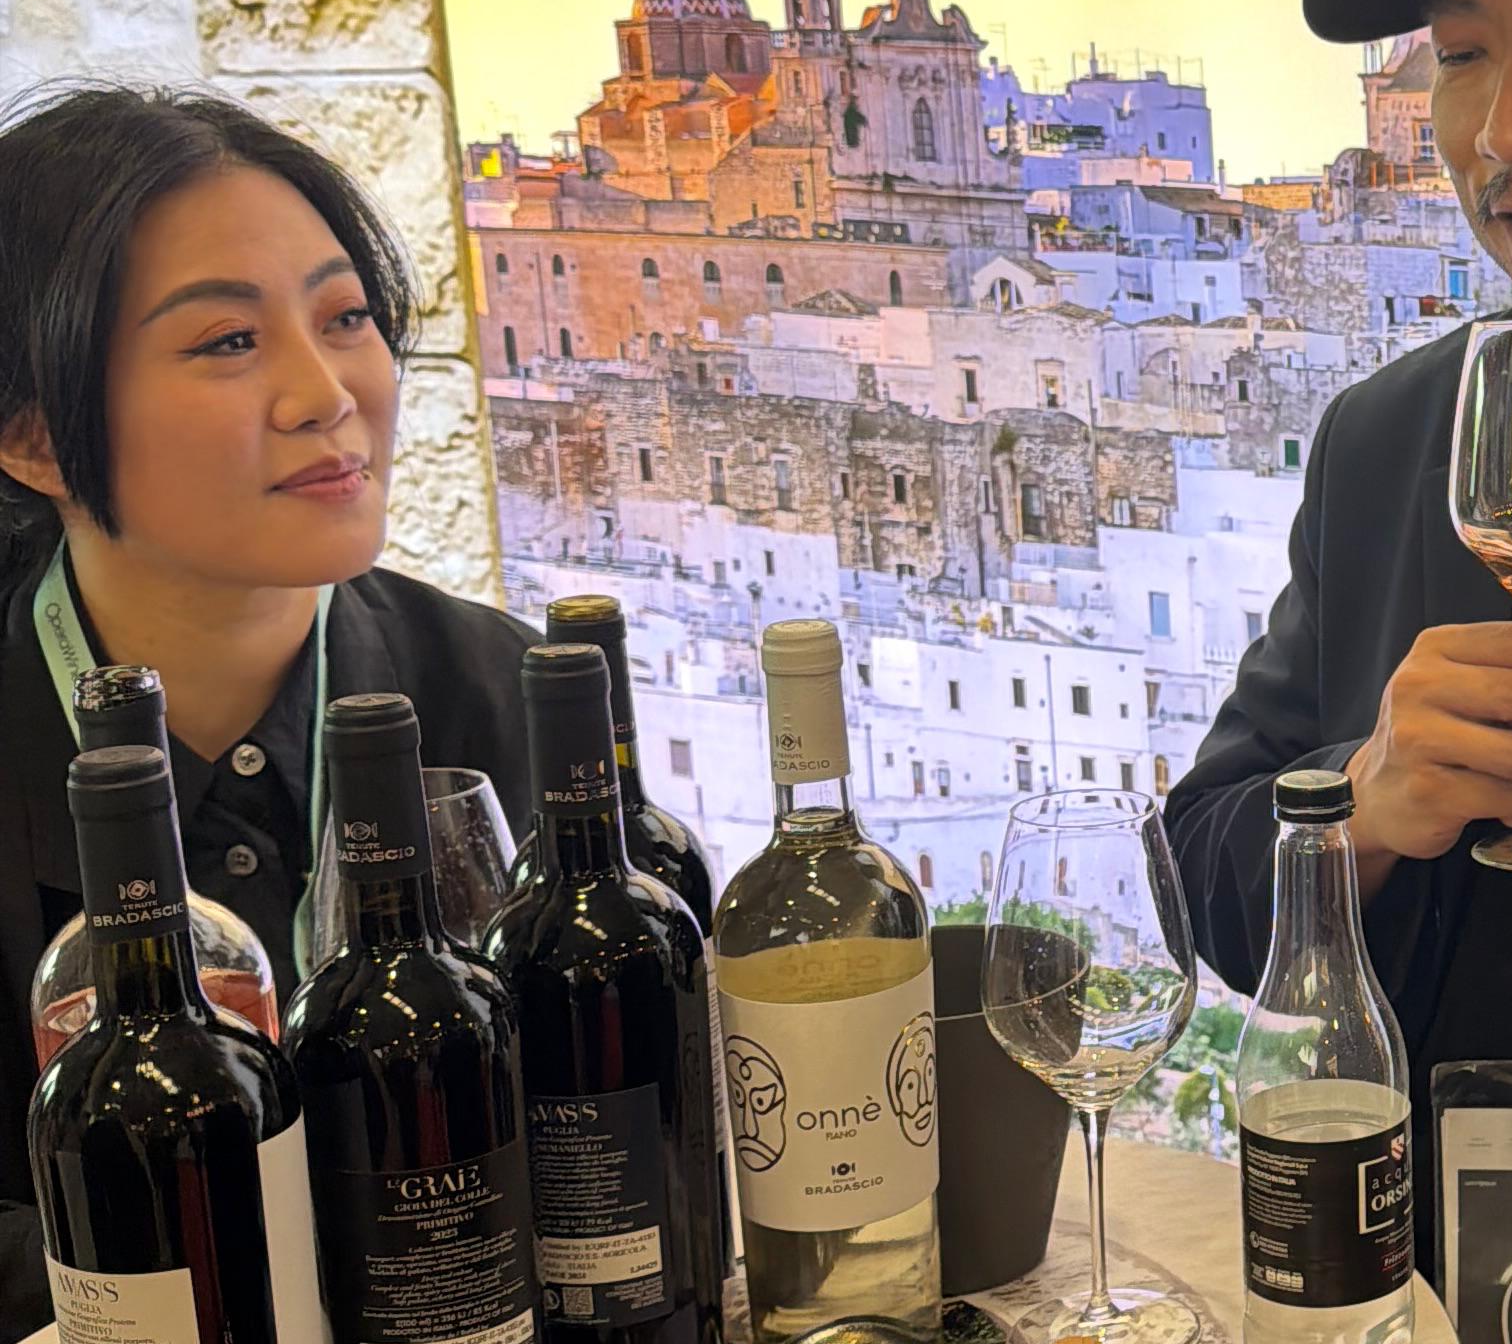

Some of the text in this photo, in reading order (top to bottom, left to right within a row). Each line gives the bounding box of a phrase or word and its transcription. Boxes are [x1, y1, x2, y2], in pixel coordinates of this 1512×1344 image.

[796, 1095, 882, 1131] onnè
[825, 1129, 857, 1142] FIANO
[804, 1176, 884, 1196] BRADASCIO
[416, 1211, 475, 1231] PRIMITIVO
